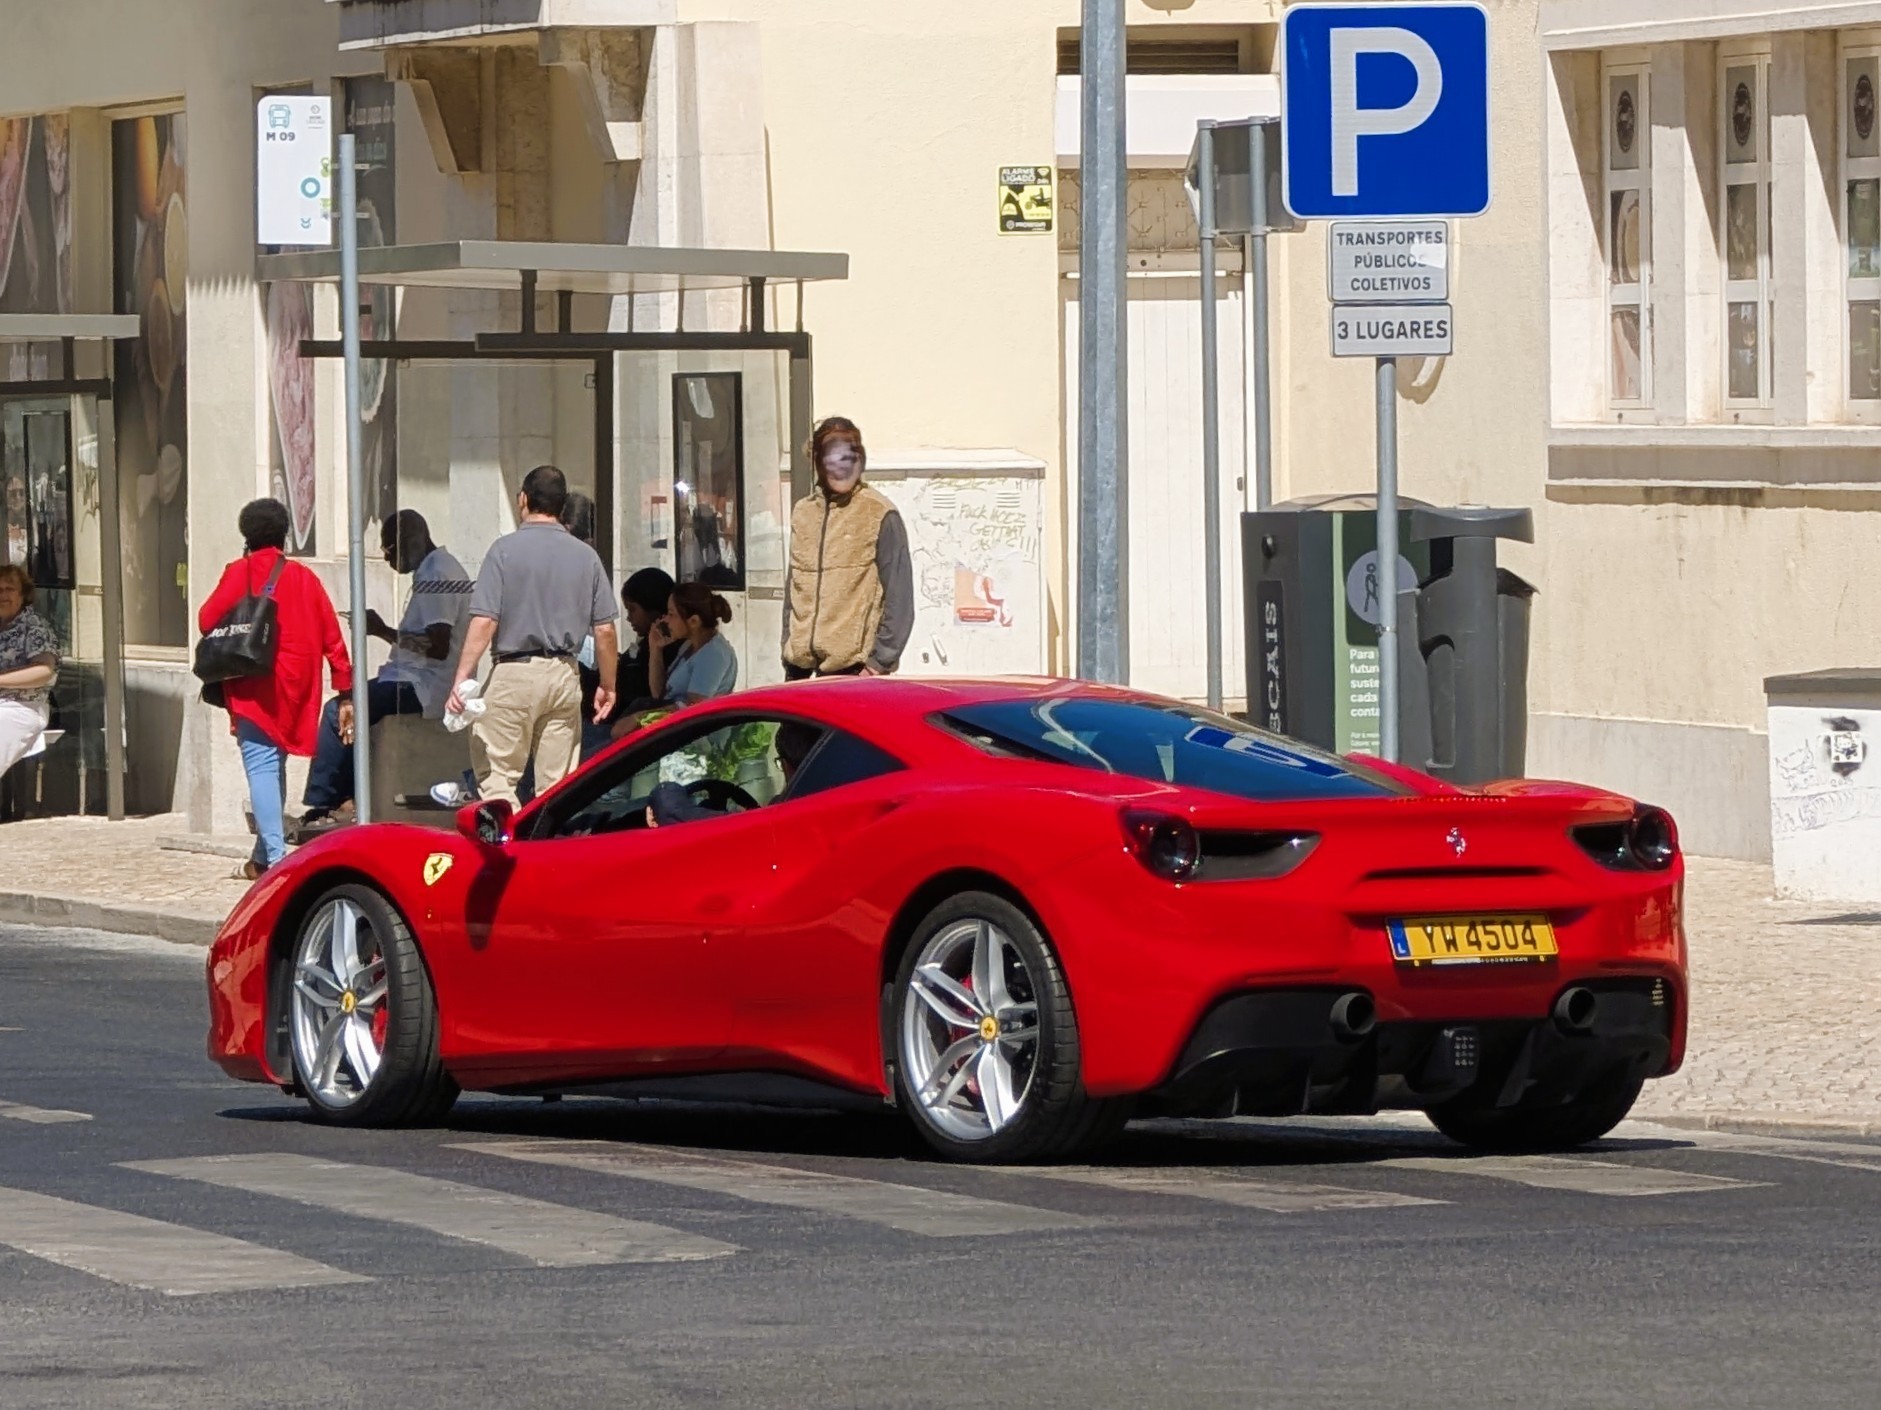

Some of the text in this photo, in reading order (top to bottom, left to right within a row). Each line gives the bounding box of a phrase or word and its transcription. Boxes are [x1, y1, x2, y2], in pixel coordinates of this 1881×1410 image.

[1329, 26, 1443, 197] P
[266, 131, 296, 141] M 09
[1336, 230, 1444, 246] TRANSPORTES
[1350, 276, 1431, 291] COLETIVOS
[1337, 319, 1448, 340] 3 LUGARES
[1350, 648, 1375, 660] Para
[1350, 692, 1378, 703] cada
